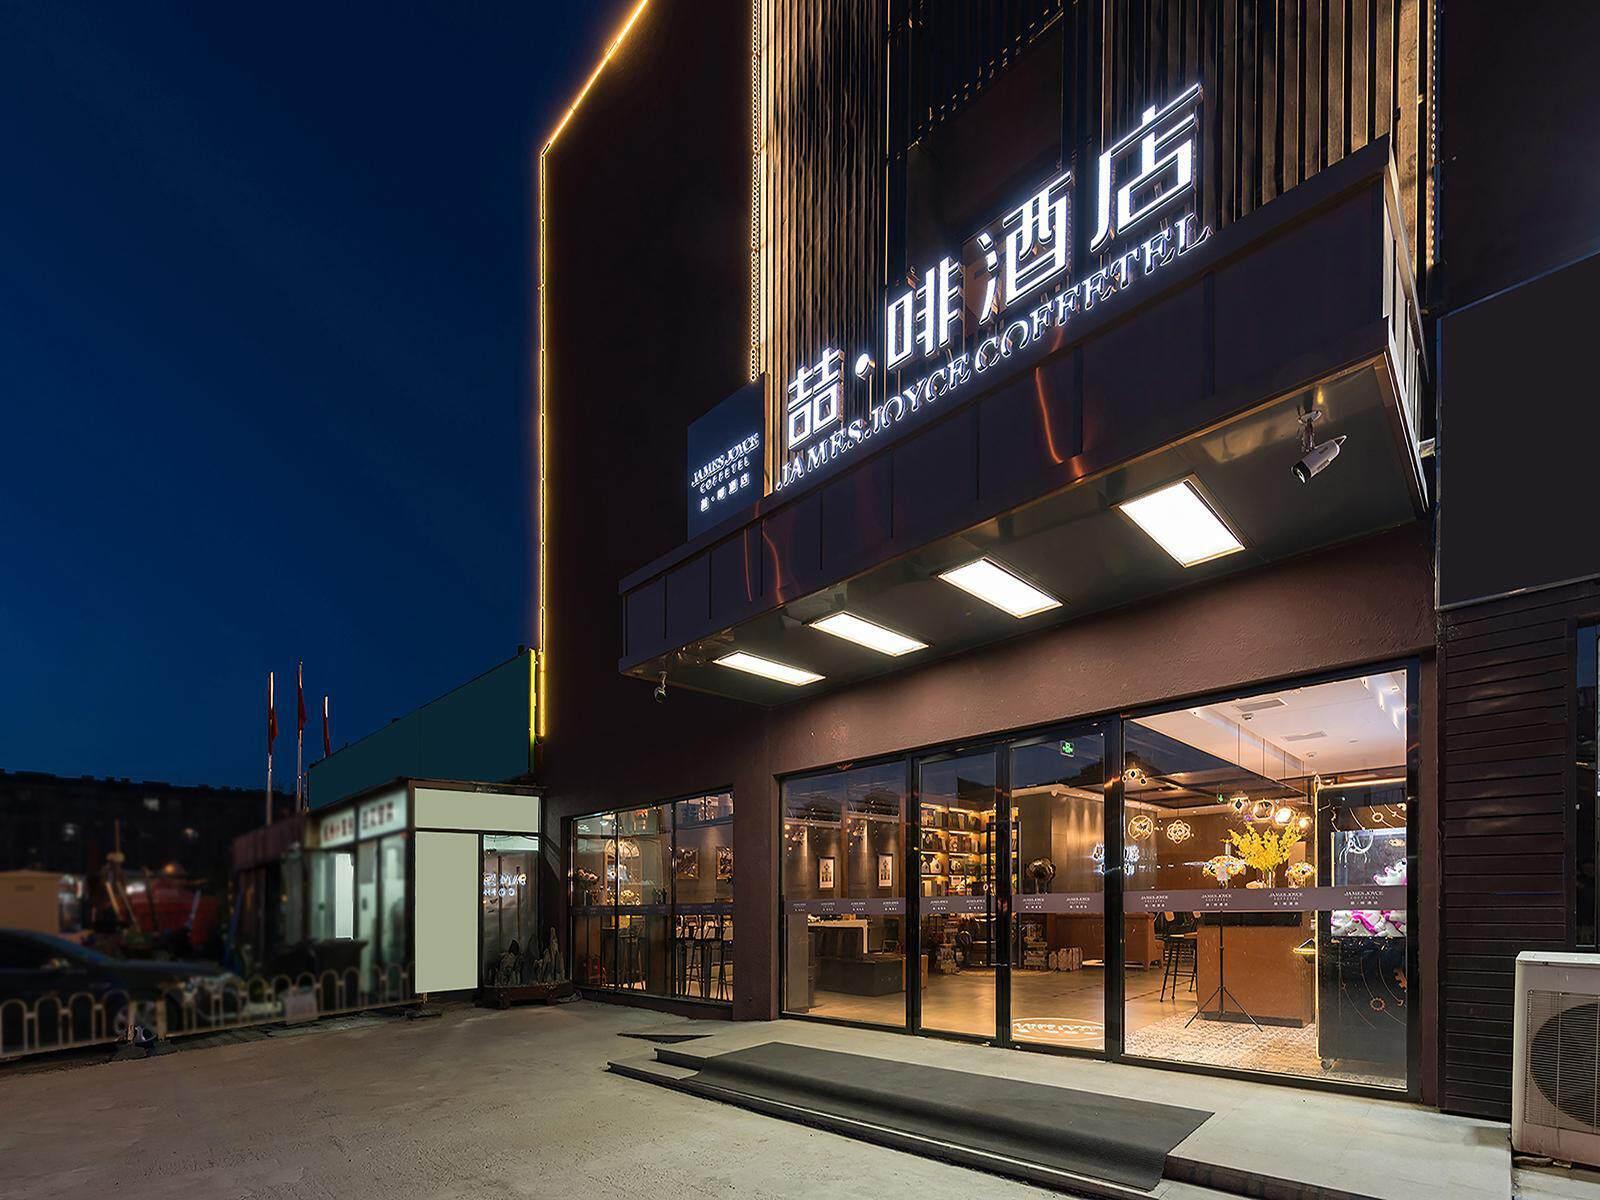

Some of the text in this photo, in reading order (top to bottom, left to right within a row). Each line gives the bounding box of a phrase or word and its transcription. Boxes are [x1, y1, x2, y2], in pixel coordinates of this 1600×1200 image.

[787, 82, 1200, 451] 喆·啡酒店
[974, 212, 1214, 374] COFFETEL
